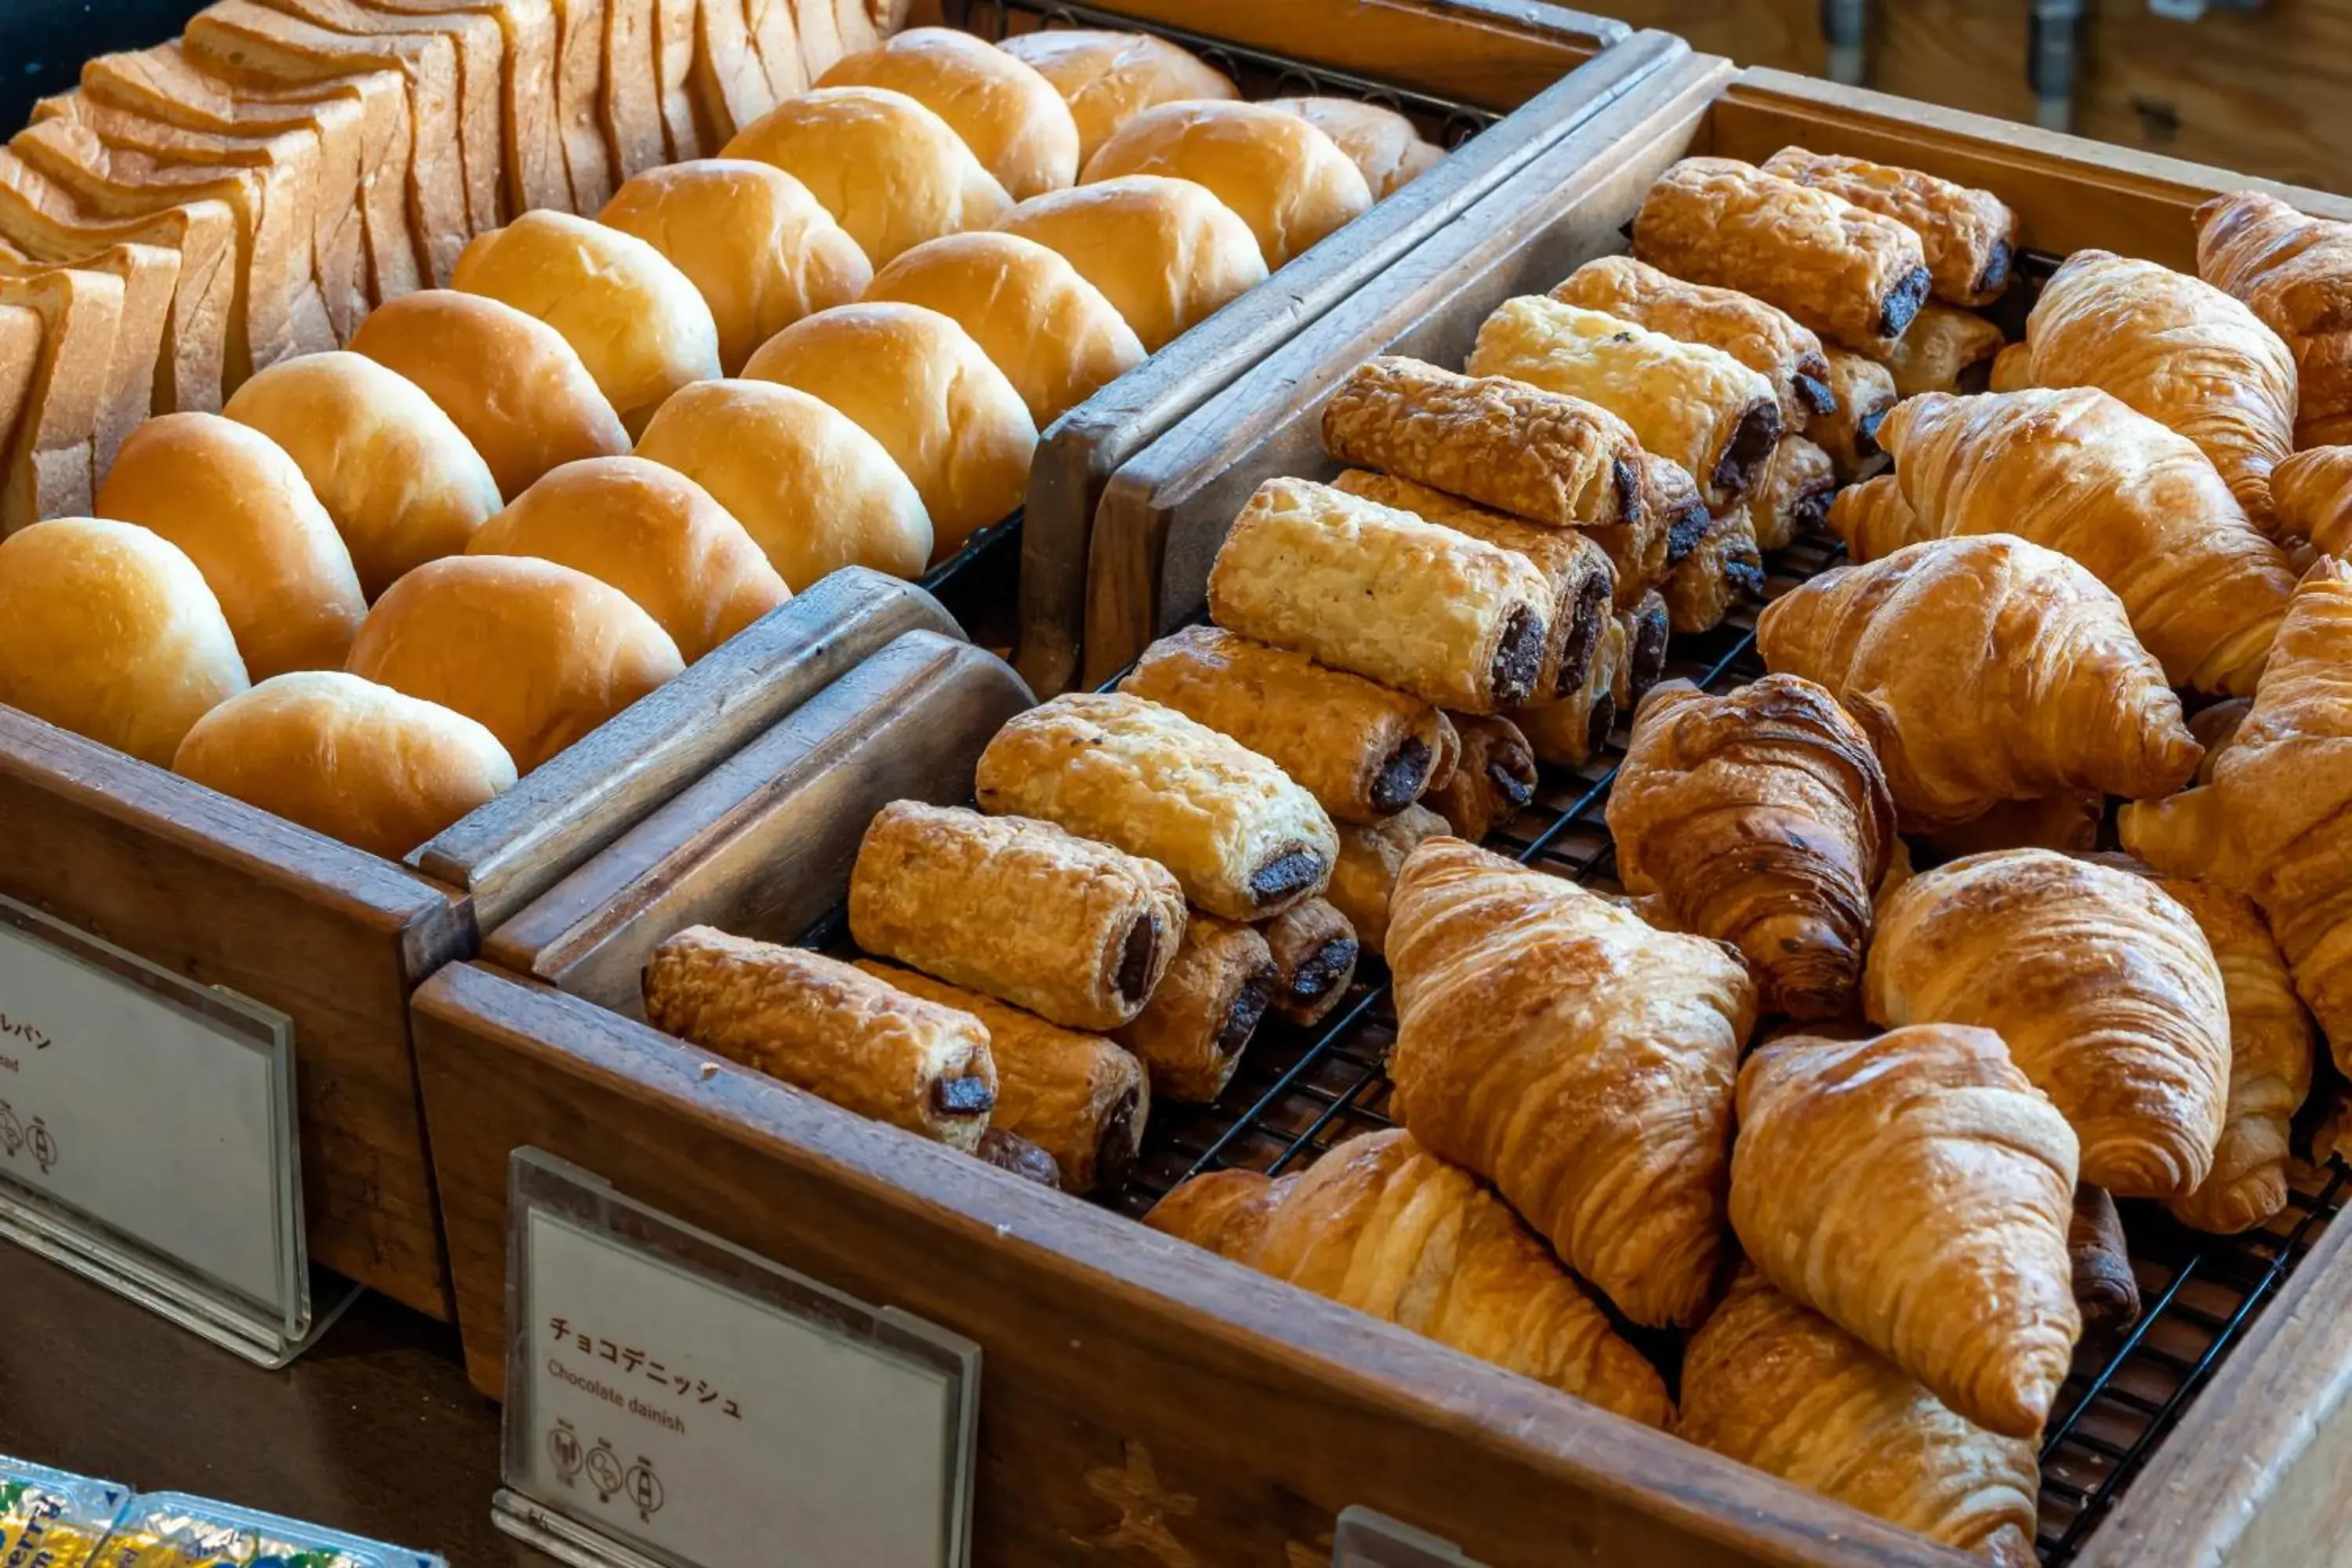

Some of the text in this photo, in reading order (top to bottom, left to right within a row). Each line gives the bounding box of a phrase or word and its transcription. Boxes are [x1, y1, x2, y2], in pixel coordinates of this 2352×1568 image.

[547, 1358, 685, 1436] Chocolate dainish
[550, 1317, 742, 1420] チョコデニッシュ
